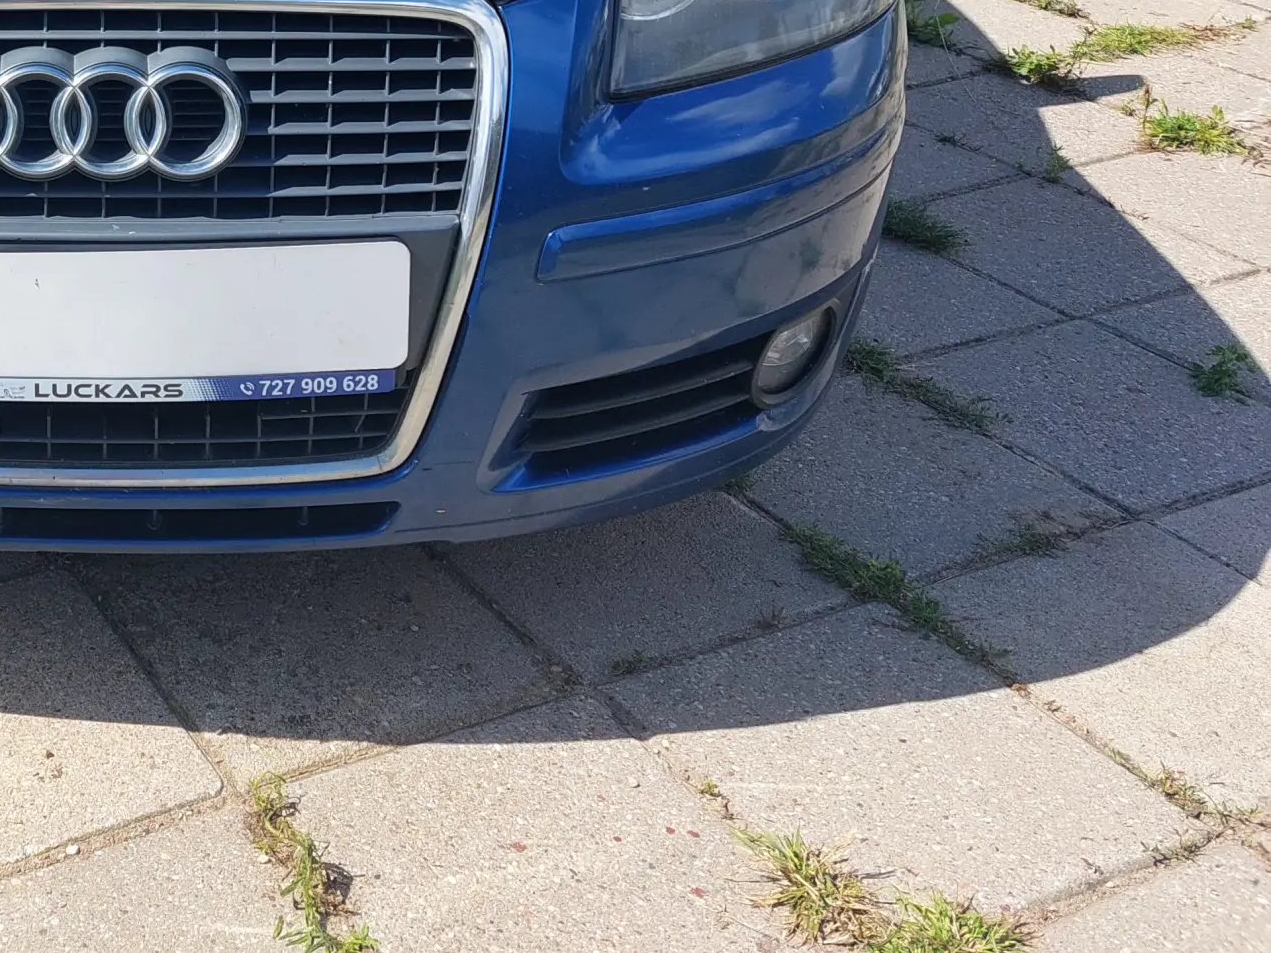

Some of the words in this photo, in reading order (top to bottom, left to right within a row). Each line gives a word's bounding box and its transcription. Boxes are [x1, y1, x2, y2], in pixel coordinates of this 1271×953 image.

[34, 382, 184, 399] LUCKARS
[259, 379, 296, 396] 727
[301, 377, 337, 394] 909
[342, 374, 379, 392] 628
